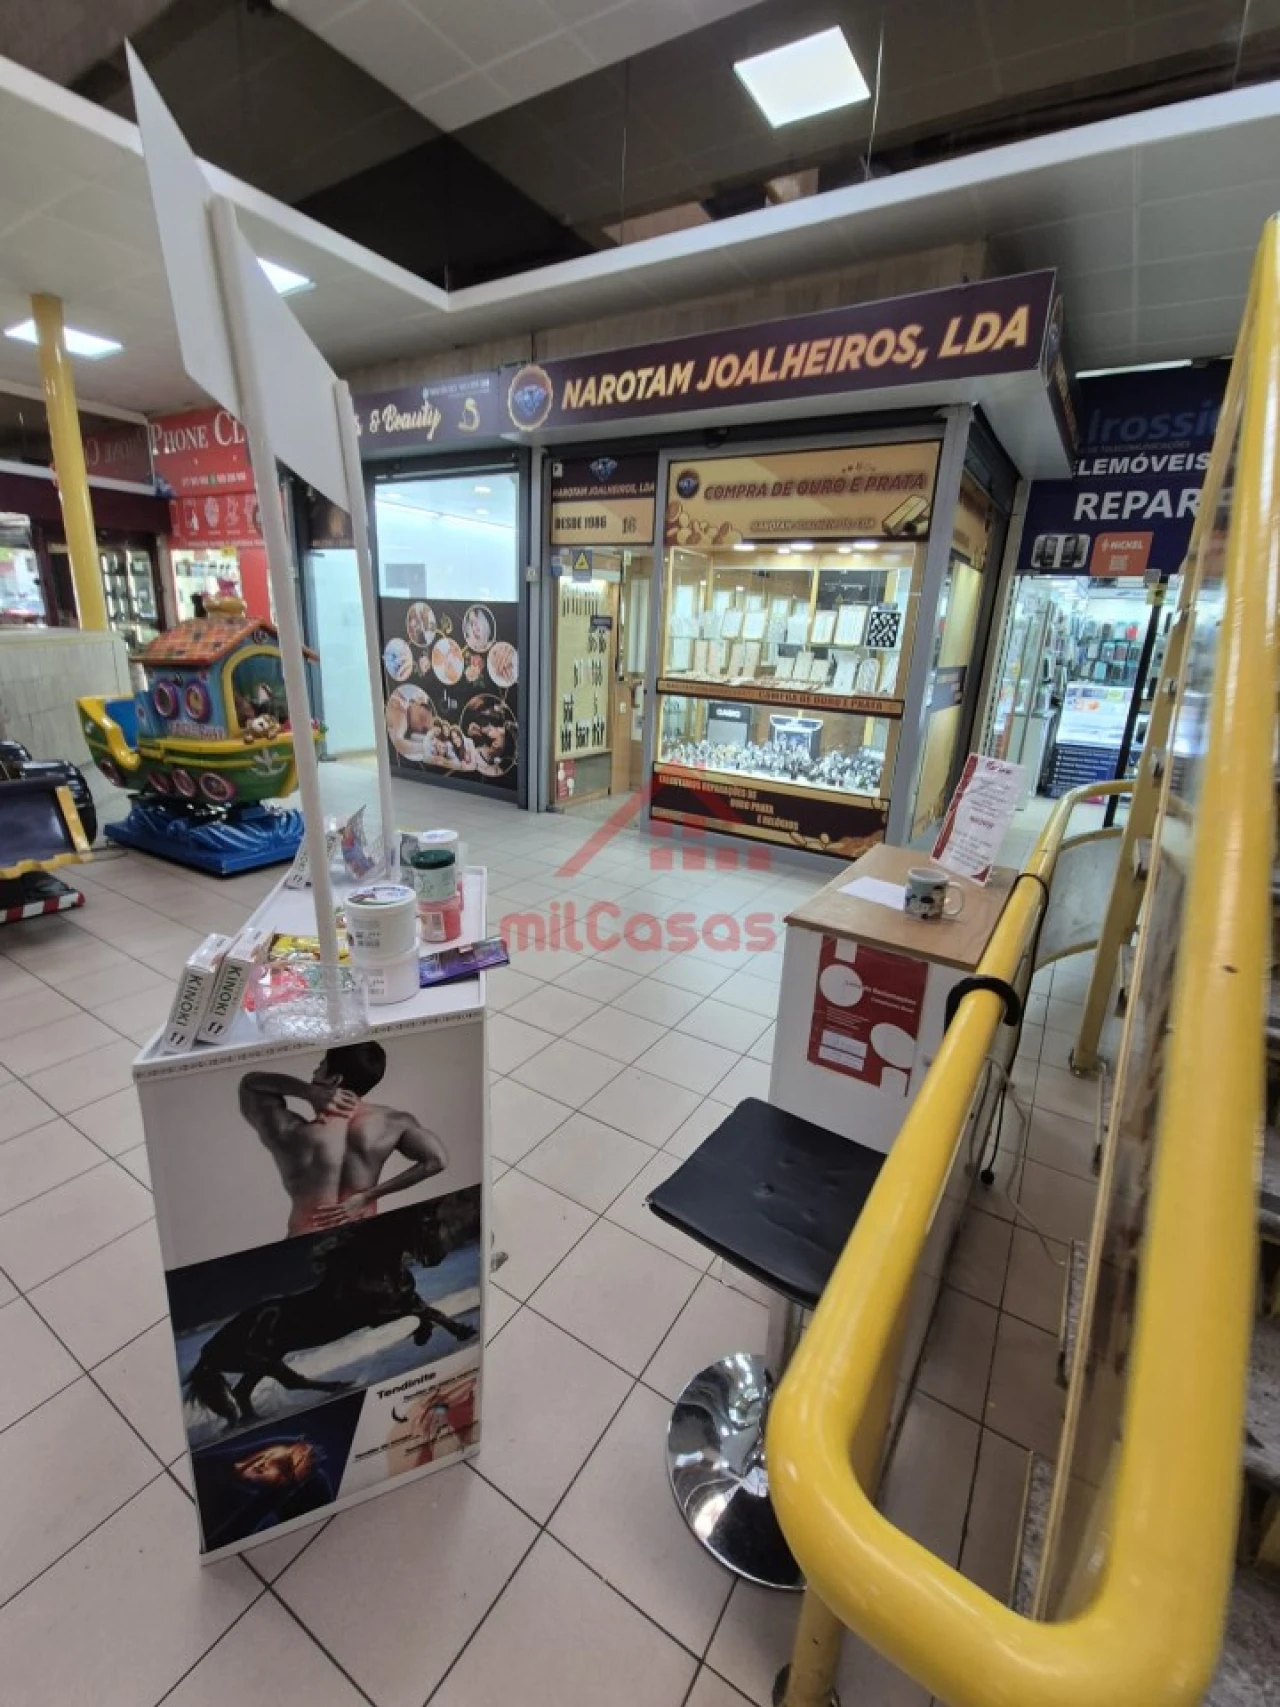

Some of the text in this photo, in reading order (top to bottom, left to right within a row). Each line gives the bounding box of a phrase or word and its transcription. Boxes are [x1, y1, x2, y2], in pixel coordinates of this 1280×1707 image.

[562, 306, 1030, 411] NAROTAM JOALHEIROS, LDA
[150, 411, 246, 455] PHONE CL
[382, 403, 441, 441] Beauty
[704, 473, 927, 501] COMPRA DE OURO E PRATA
[1074, 488, 1202, 521] REPAR
[555, 515, 581, 530] DESDE
[377, 1372, 437, 1399] Tendinite
